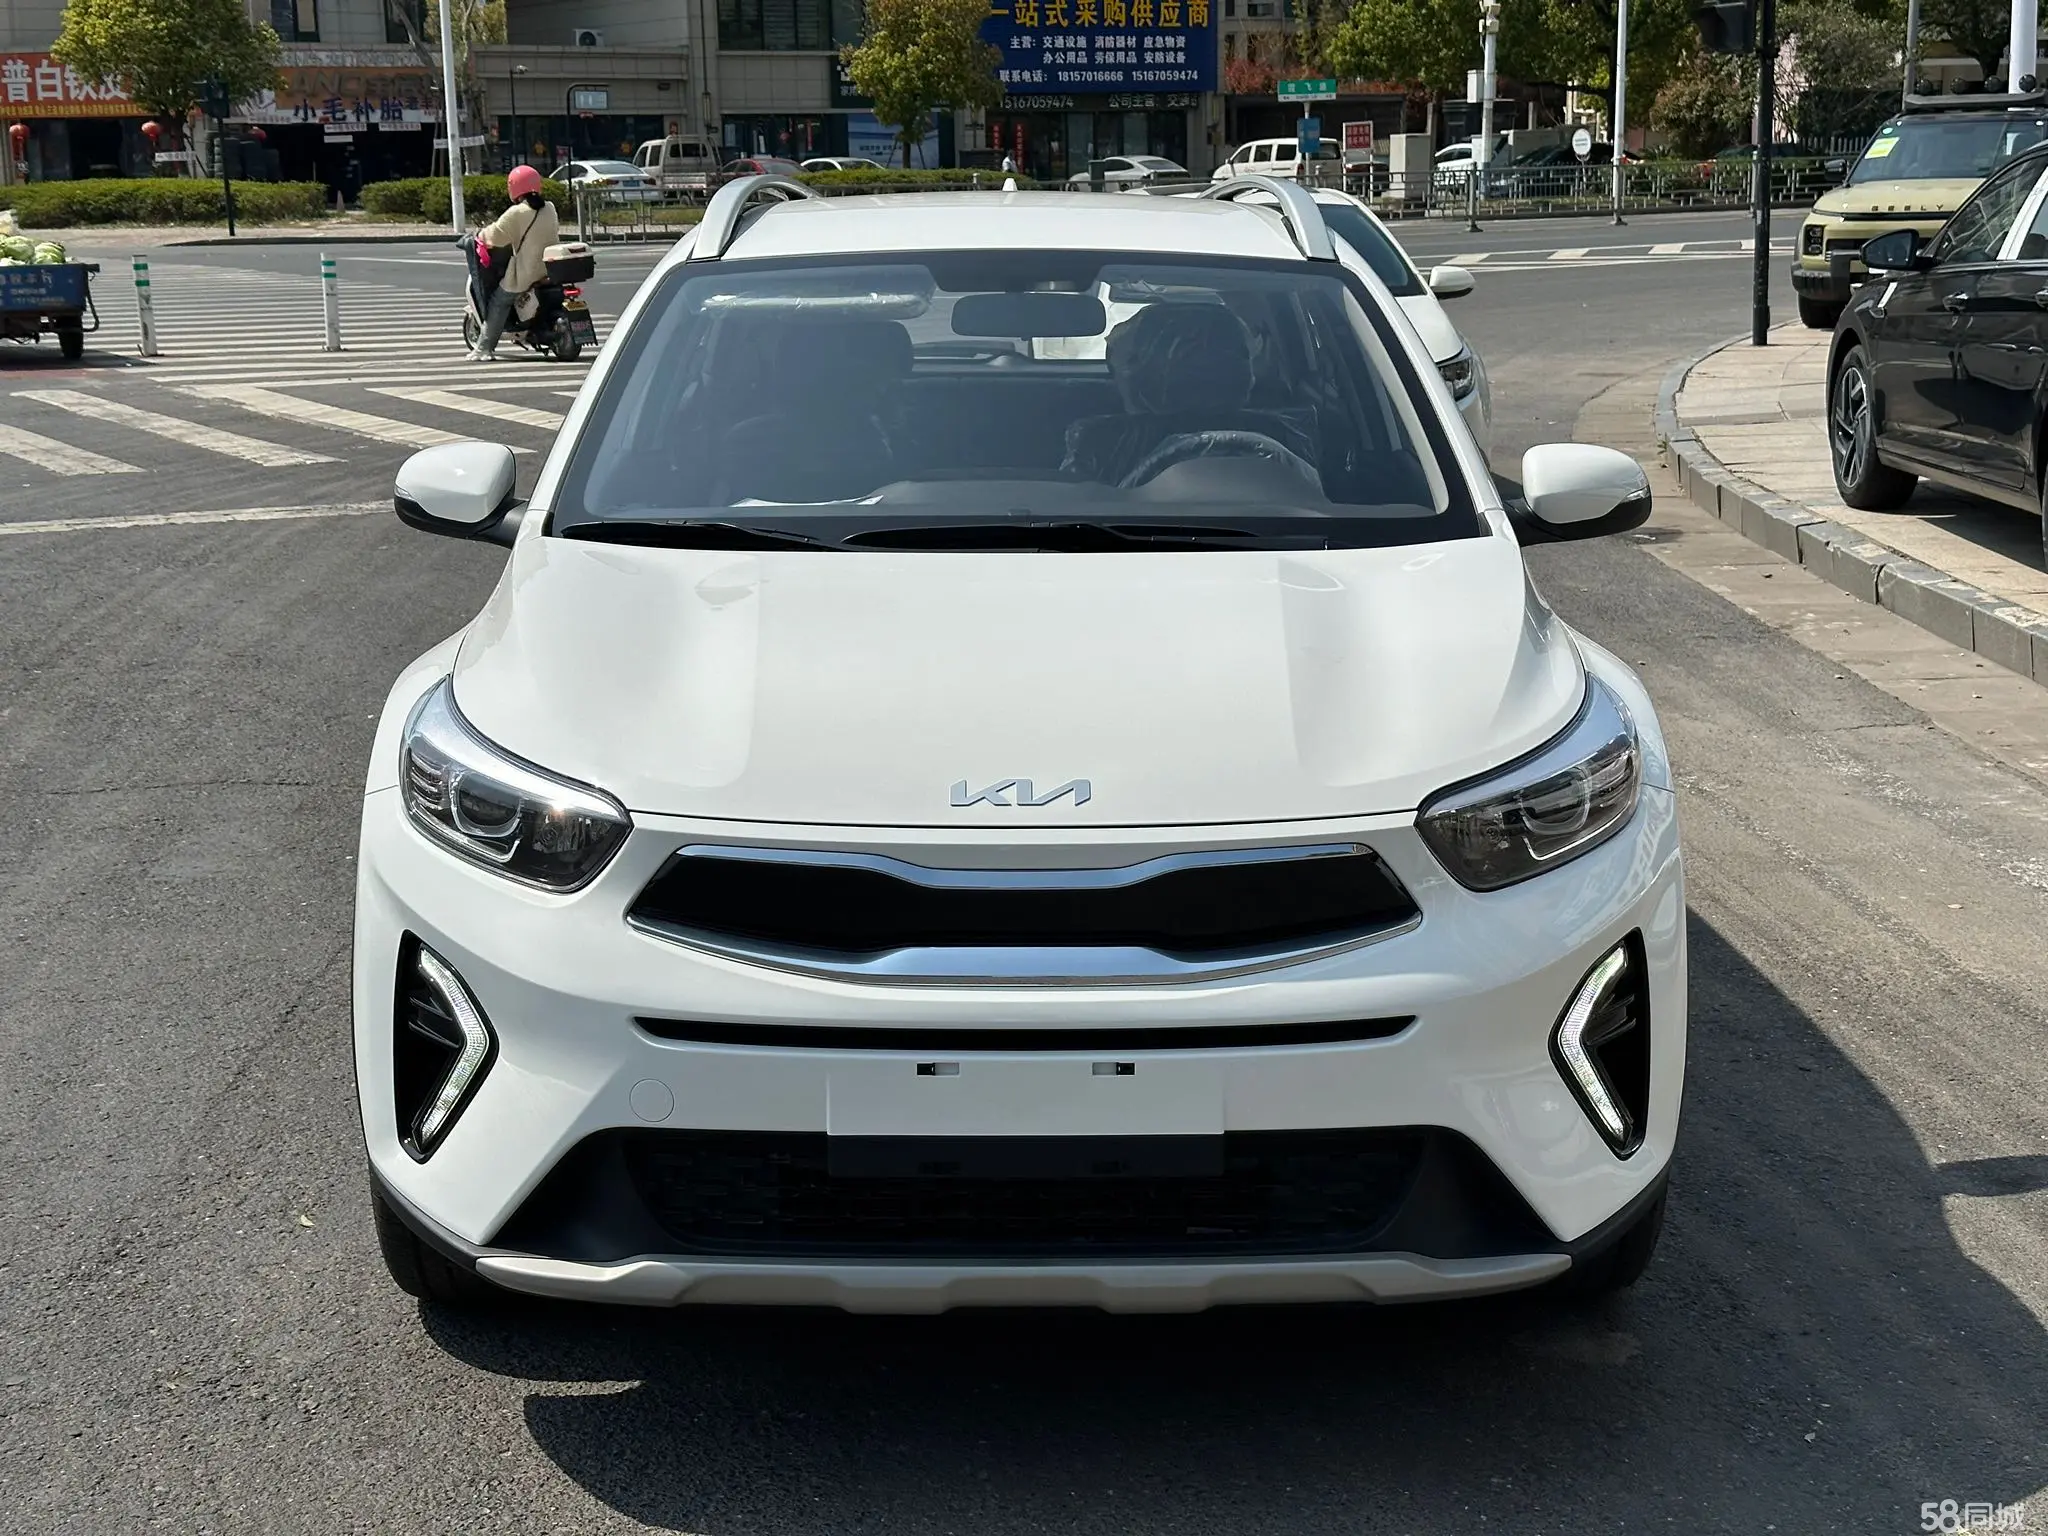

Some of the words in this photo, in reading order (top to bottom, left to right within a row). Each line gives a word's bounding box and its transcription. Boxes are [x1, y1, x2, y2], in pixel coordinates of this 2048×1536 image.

[991, 0, 1209, 27] 一站式采购供应商
[1010, 36, 1036, 48] 主营:
[1043, 36, 1087, 48] 交通设施
[1095, 36, 1136, 48] 消防器材
[1043, 52, 1087, 64] 办公用品
[1094, 52, 1137, 64] 劳保用品
[1144, 52, 1186, 64] 安防设备
[999, 70, 1048, 82] 联系电话:
[1057, 70, 1124, 82] 18157016666
[1132, 70, 1198, 81] 15167059474
[293, 97, 403, 122] 小毛补胎
[1871, 204, 1944, 212] GEELY
[950, 779, 1092, 807] KIA
